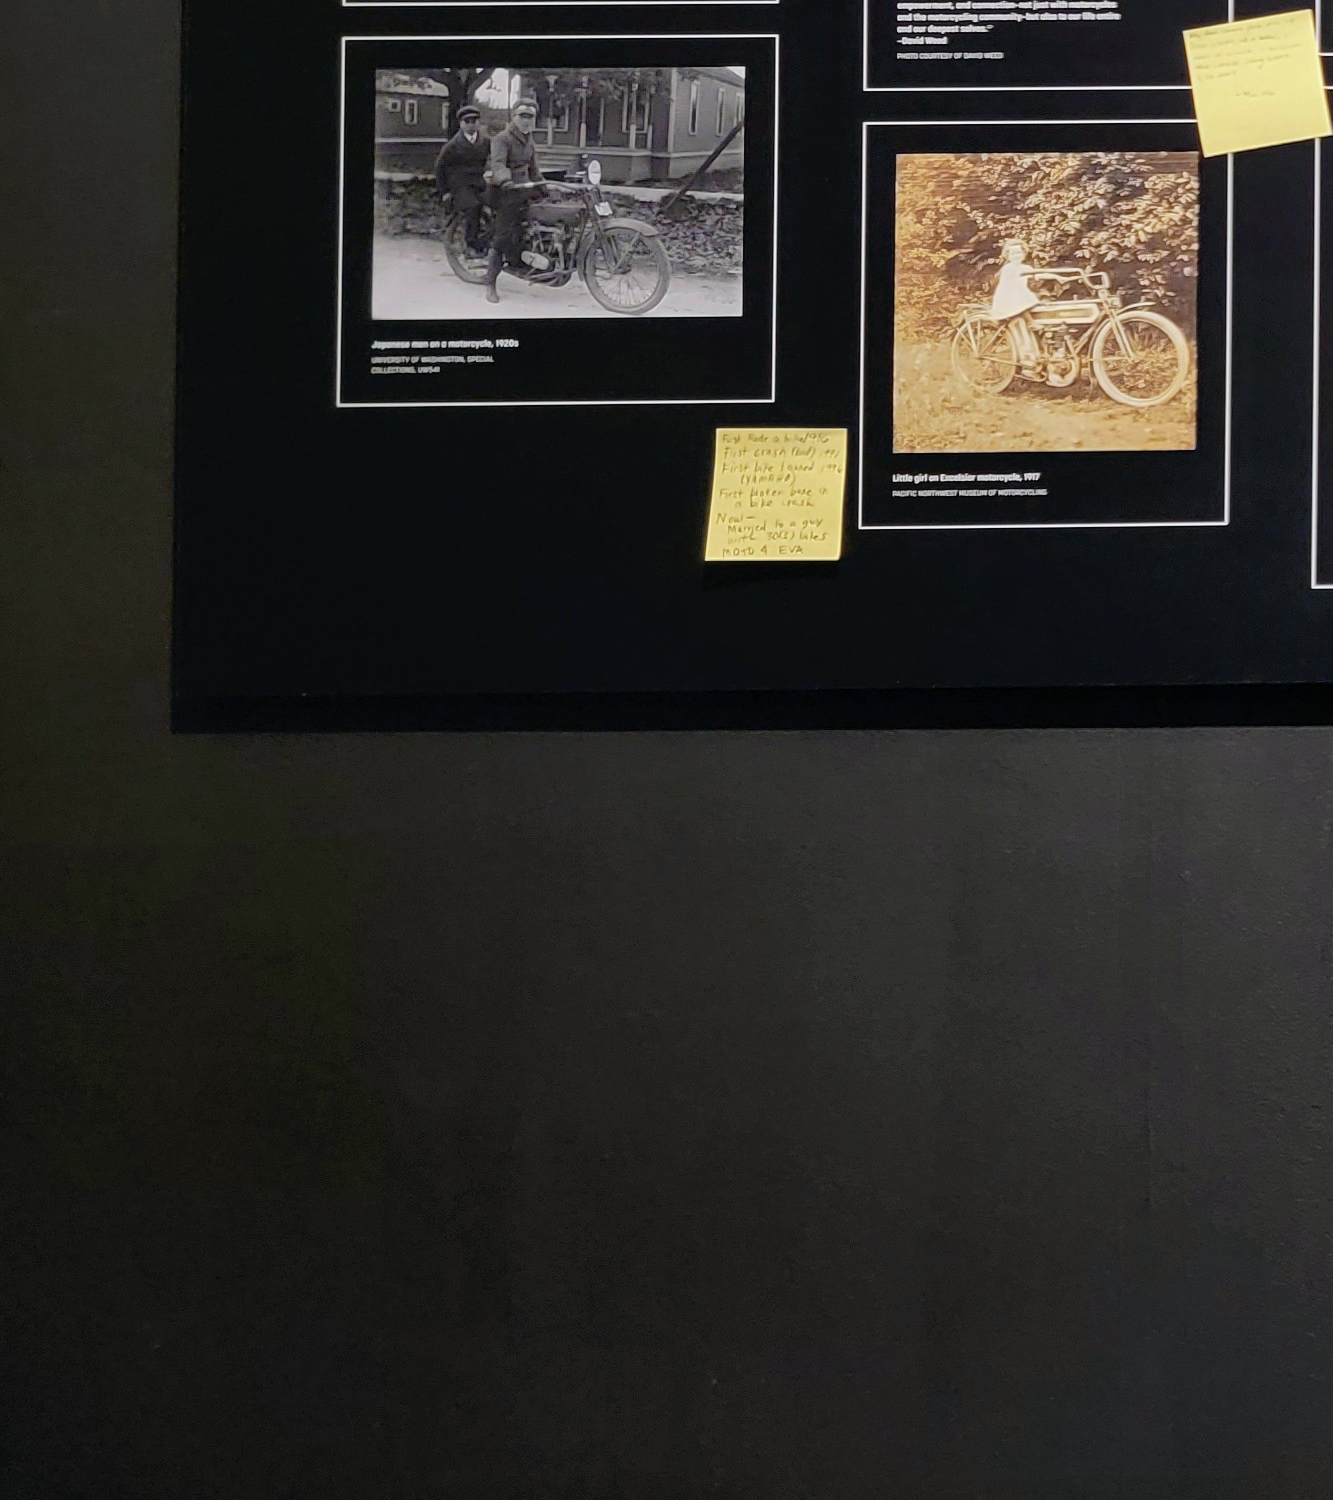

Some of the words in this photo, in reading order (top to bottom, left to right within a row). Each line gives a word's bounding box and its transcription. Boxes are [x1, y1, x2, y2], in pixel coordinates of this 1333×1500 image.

[371, 341, 410, 350] Japanese
[448, 340, 494, 349] motorcycle,
[496, 339, 519, 347] 1920s
[892, 474, 913, 482] Little
[914, 473, 927, 484] girl
[940, 473, 976, 482] Excelsior
[977, 473, 1023, 483] motorcycle,
[1024, 473, 1041, 481] 1917
